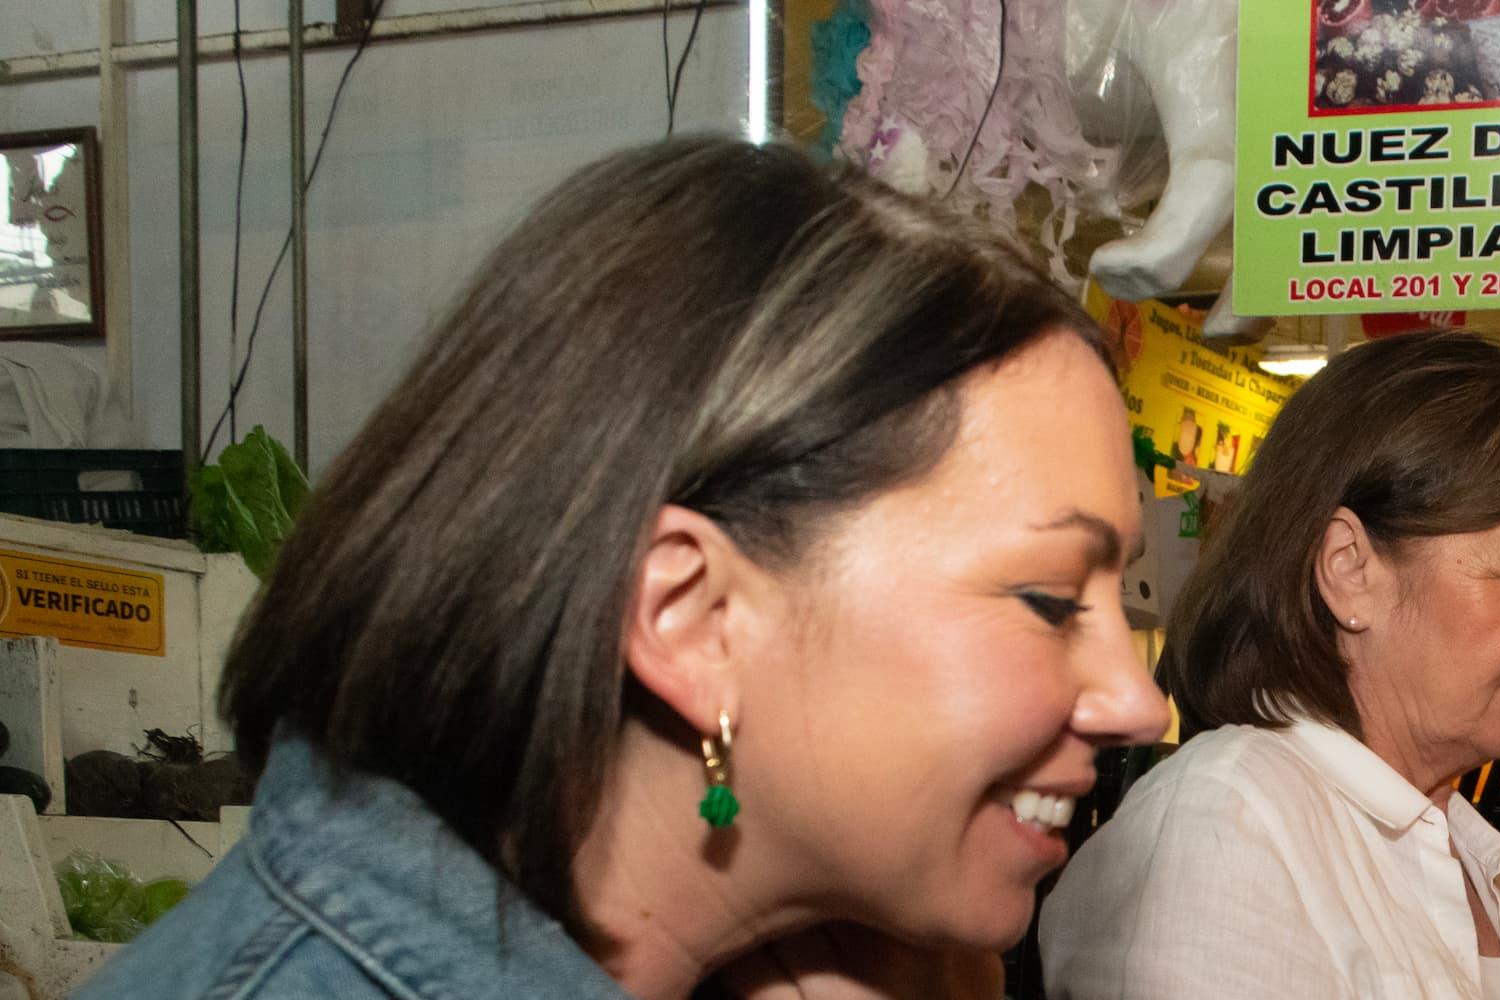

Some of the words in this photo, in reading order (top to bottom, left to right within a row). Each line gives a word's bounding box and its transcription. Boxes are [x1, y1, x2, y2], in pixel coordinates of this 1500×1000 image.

[1274, 126, 1449, 167] NUEZ
[1289, 278, 1382, 301] LOCAL
[1392, 275, 1441, 298] 201
[1452, 274, 1471, 297] Y
[16, 569, 29, 581] SI
[32, 571, 68, 587] TIENE
[70, 576, 84, 589] EL
[87, 578, 120, 593] SELLO
[16, 586, 151, 622] VERIFICADO
